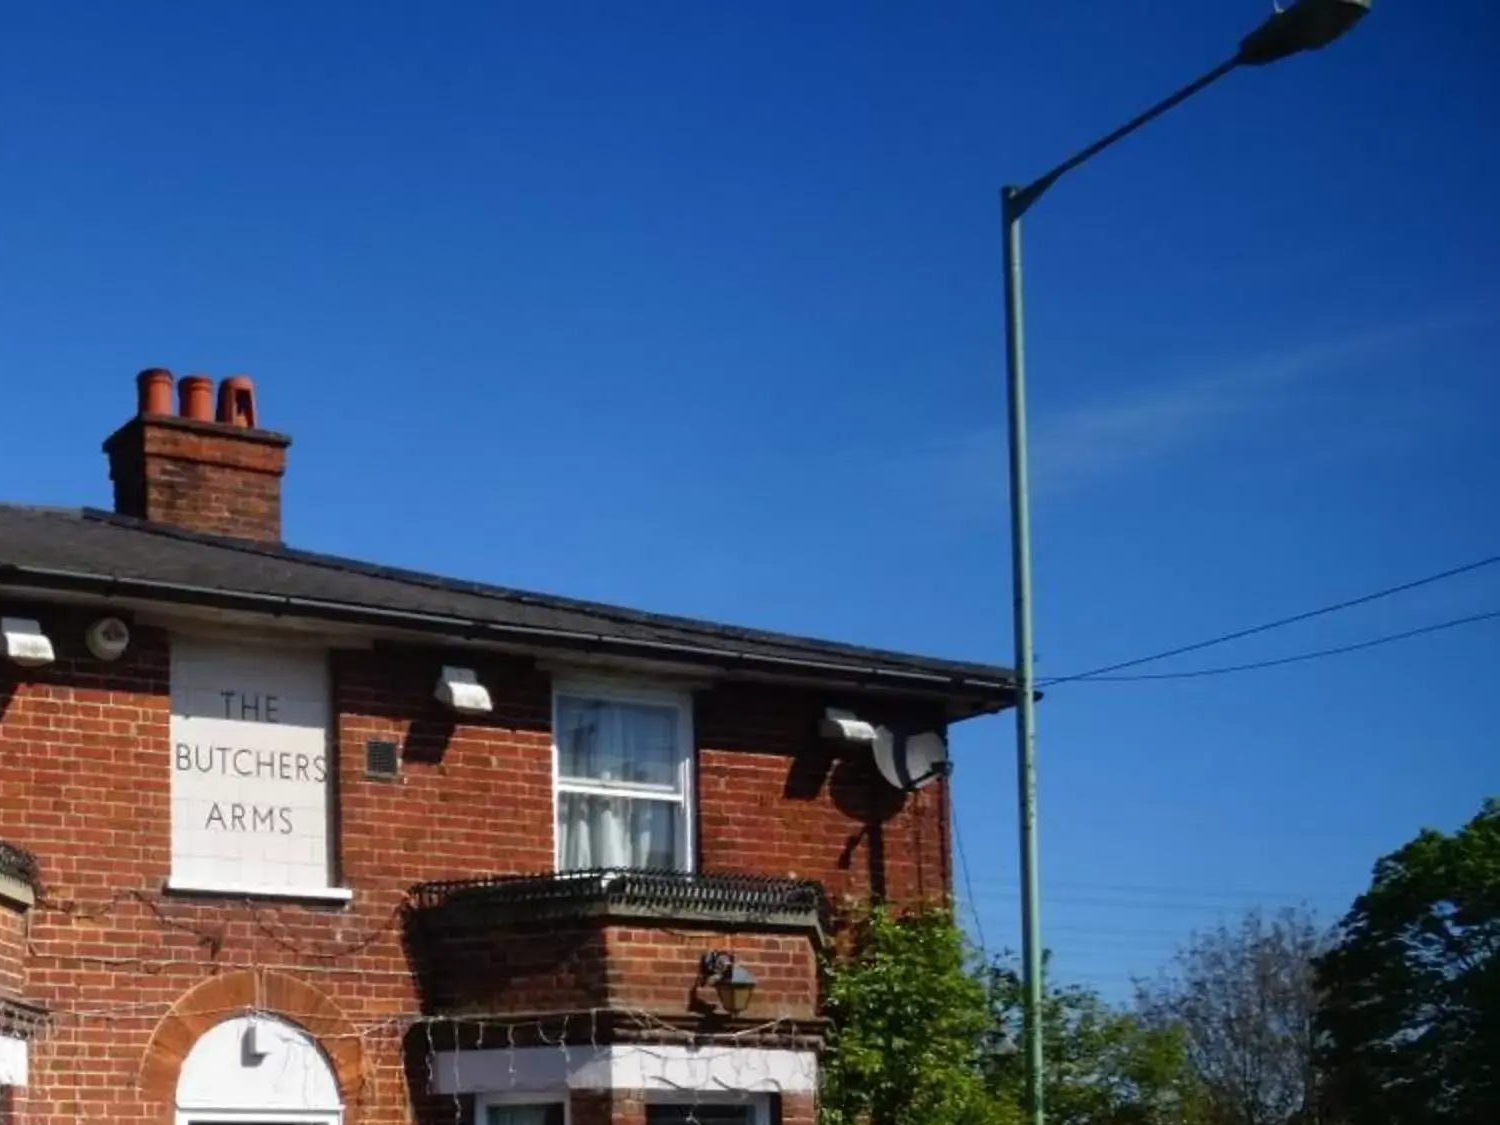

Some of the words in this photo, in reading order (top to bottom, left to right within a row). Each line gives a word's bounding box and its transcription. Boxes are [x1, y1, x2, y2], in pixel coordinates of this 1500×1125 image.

[220, 688, 279, 724] THE
[175, 742, 328, 783] BUTCHERS
[205, 802, 293, 835] ARMS
